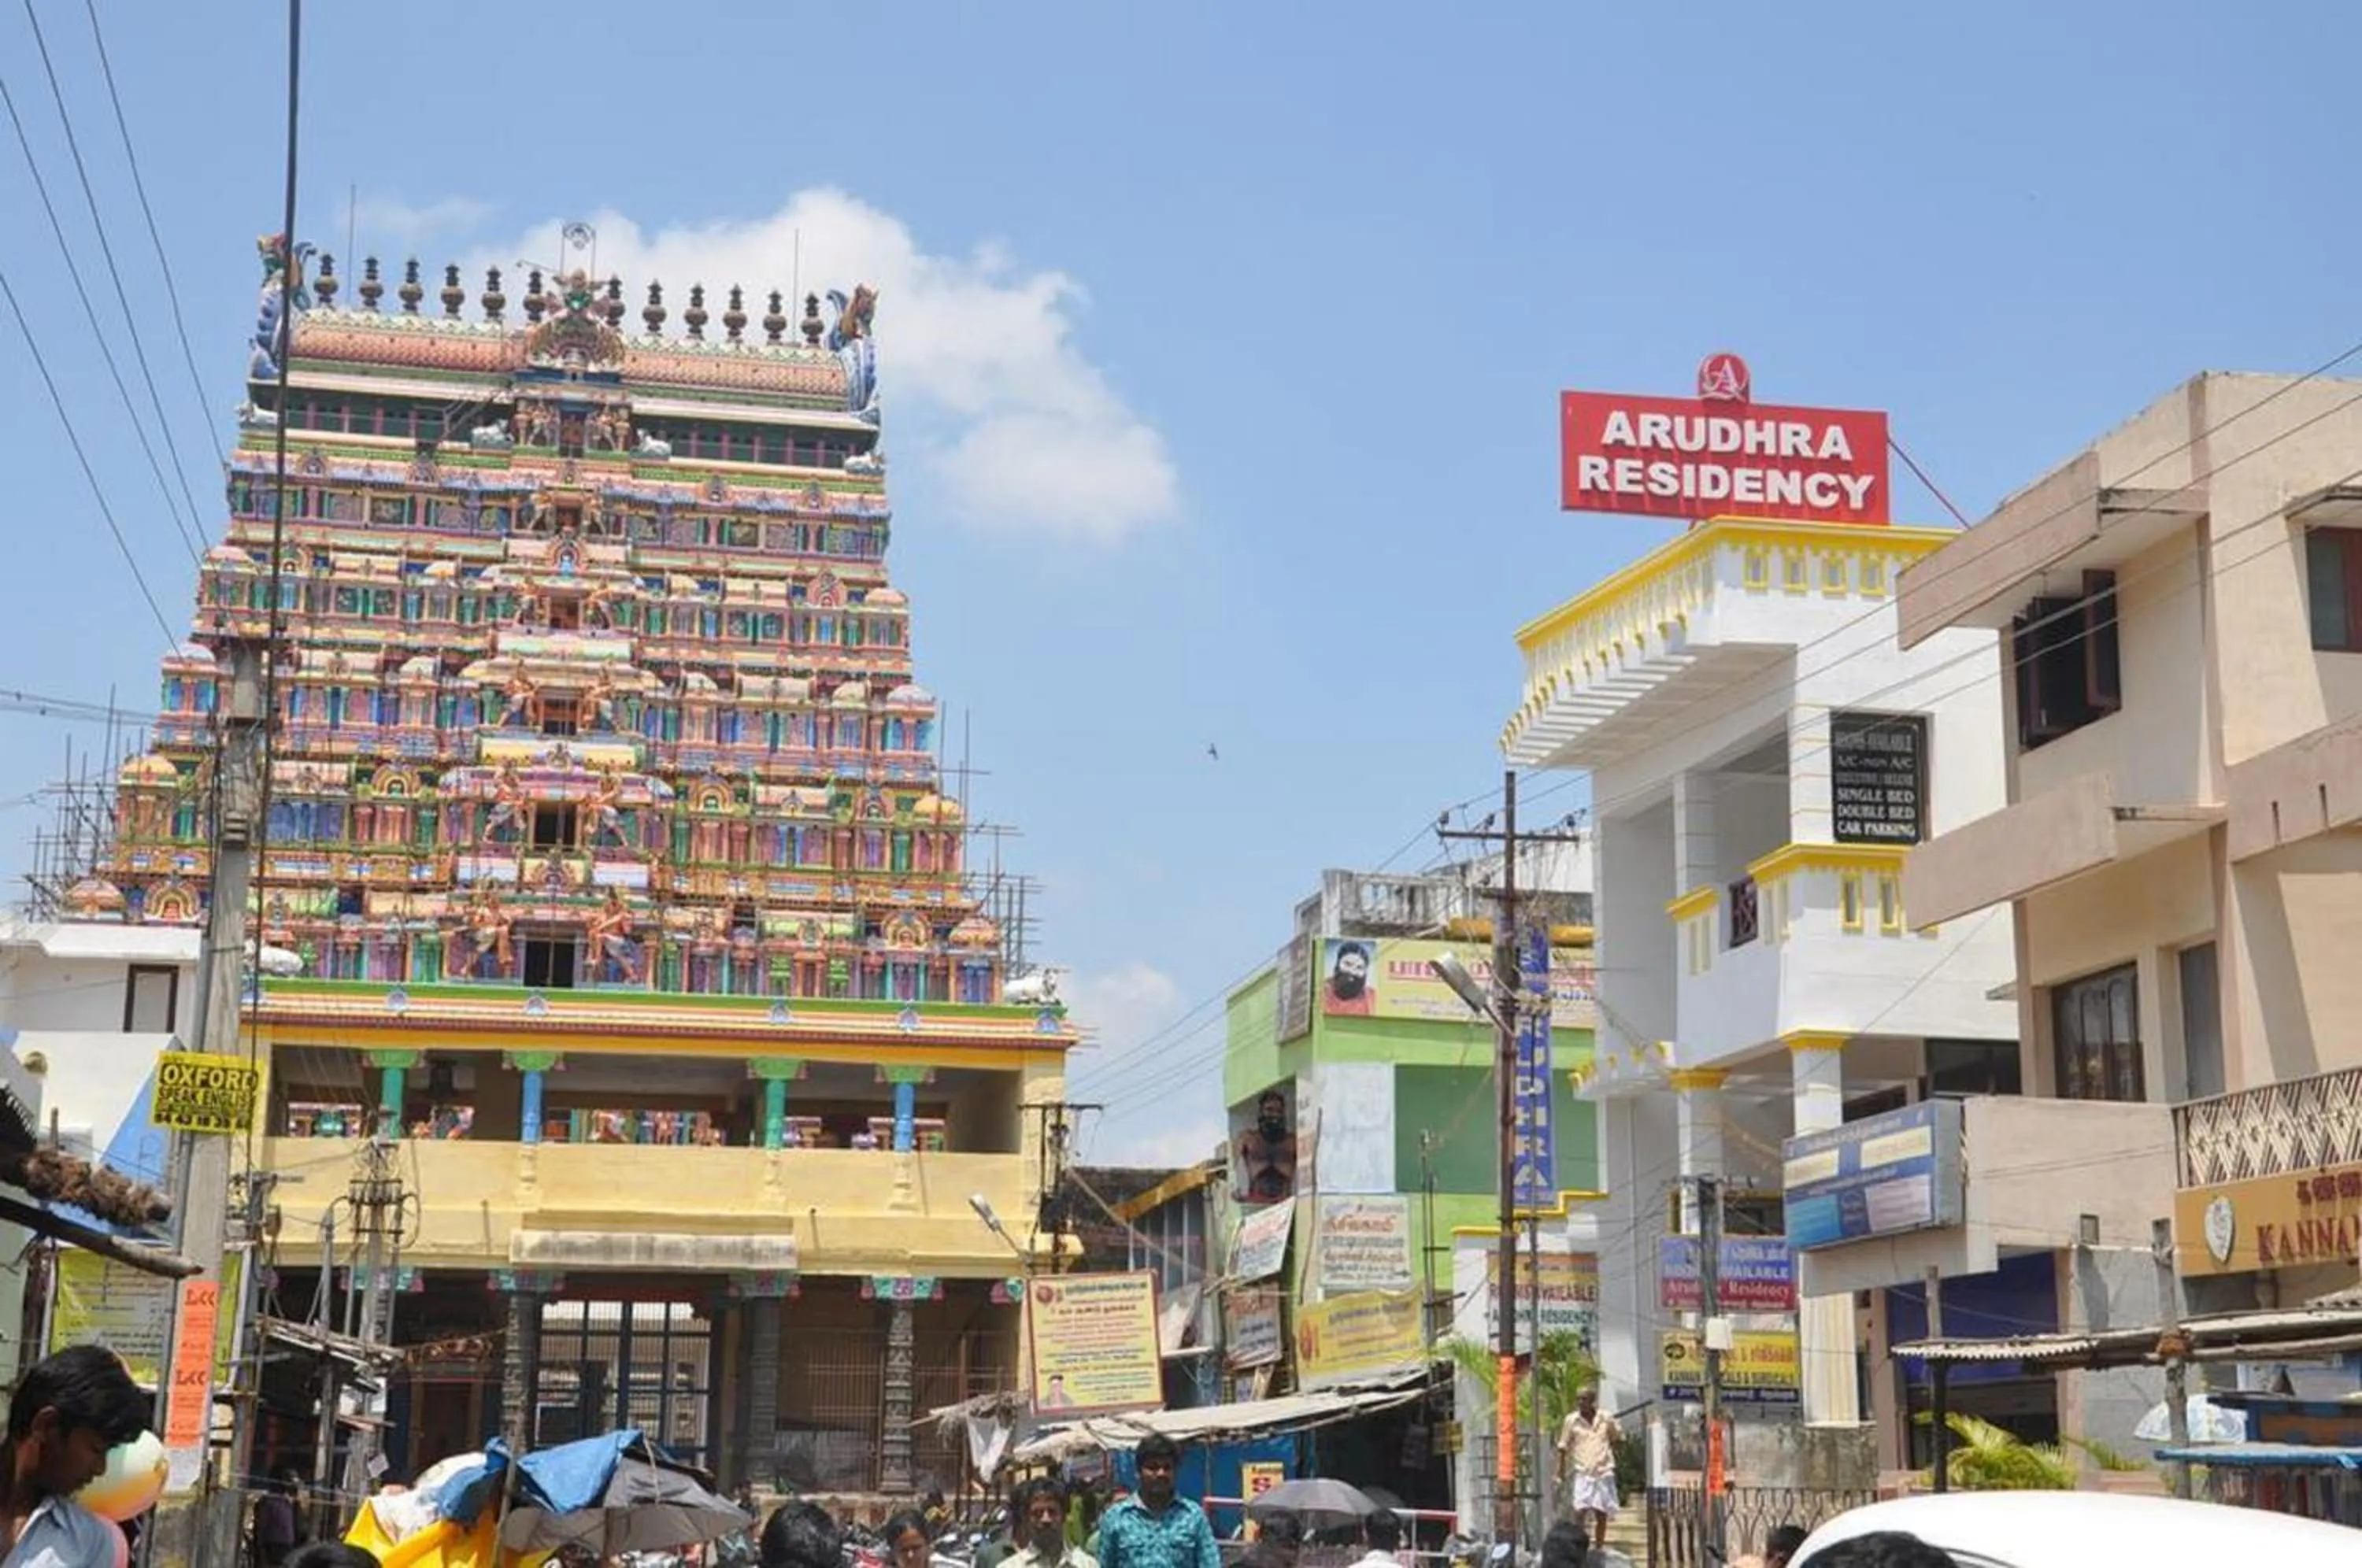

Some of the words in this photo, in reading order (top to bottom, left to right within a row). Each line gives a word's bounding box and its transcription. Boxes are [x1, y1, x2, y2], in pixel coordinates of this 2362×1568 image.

[1601, 410, 1853, 461] ARUDHRA
[1579, 454, 1875, 510] RESIDENCY
[1837, 788, 1883, 802] SINGLE
[1886, 790, 1915, 803] BED
[1838, 804, 1886, 819] DOUBLE
[1889, 805, 1916, 820] BED
[1838, 821, 1862, 834] CAR
[1864, 823, 1916, 837] PARKING
[163, 1063, 257, 1091] OXFORD
[1728, 1281, 1790, 1300] Residency
